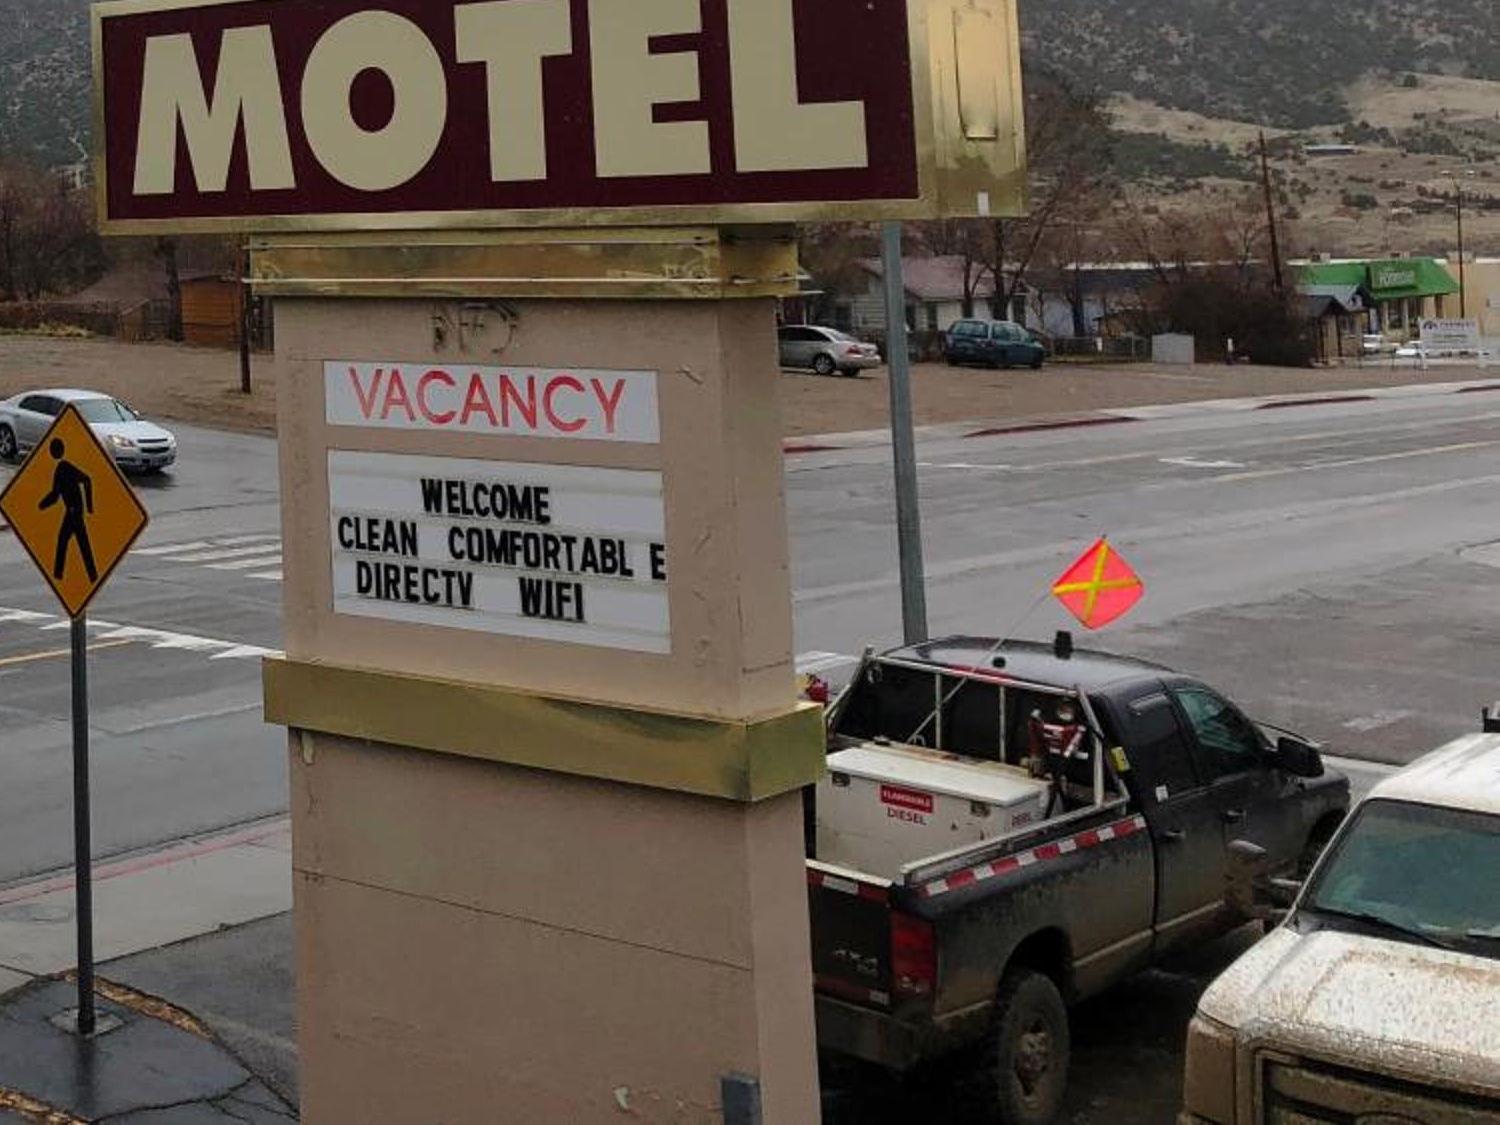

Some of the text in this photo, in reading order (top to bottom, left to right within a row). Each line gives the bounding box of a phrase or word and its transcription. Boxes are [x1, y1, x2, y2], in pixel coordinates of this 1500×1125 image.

[347, 366, 627, 434] VACANCY
[420, 477, 551, 525] WELCOME
[337, 516, 418, 557] CLEAN
[355, 560, 585, 622] DIRECTV WIFI
[887, 806, 927, 826] DIESEL
